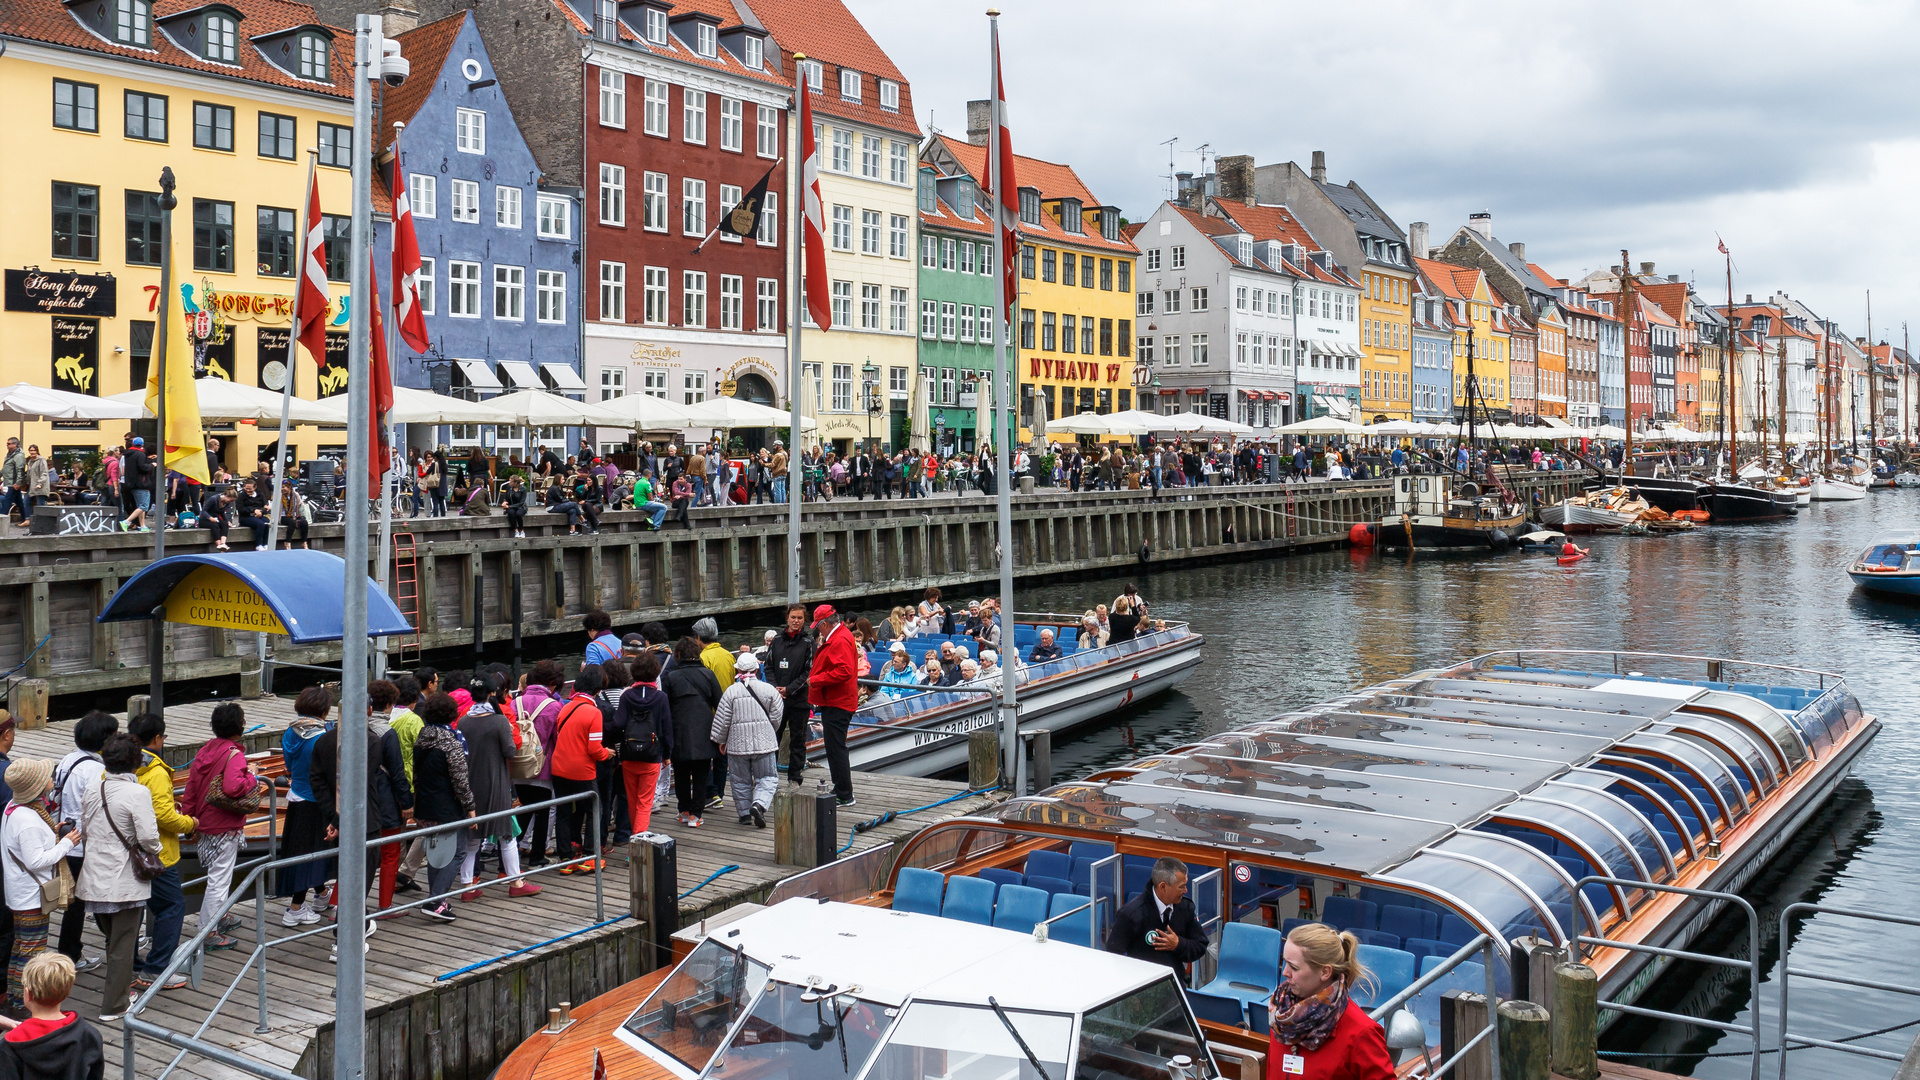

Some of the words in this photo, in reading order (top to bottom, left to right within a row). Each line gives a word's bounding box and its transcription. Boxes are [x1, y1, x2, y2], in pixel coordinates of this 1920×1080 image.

[24, 272, 65, 297] Hong
[67, 278, 98, 298] kong
[38, 296, 85, 311] nightclub
[1030, 358, 1099, 381] NYHAVN
[1106, 363, 1120, 382] 17
[1132, 367, 1148, 385] 17
[191, 587, 232, 604] CANAL
[190, 605, 277, 628] COPENHAGEN
